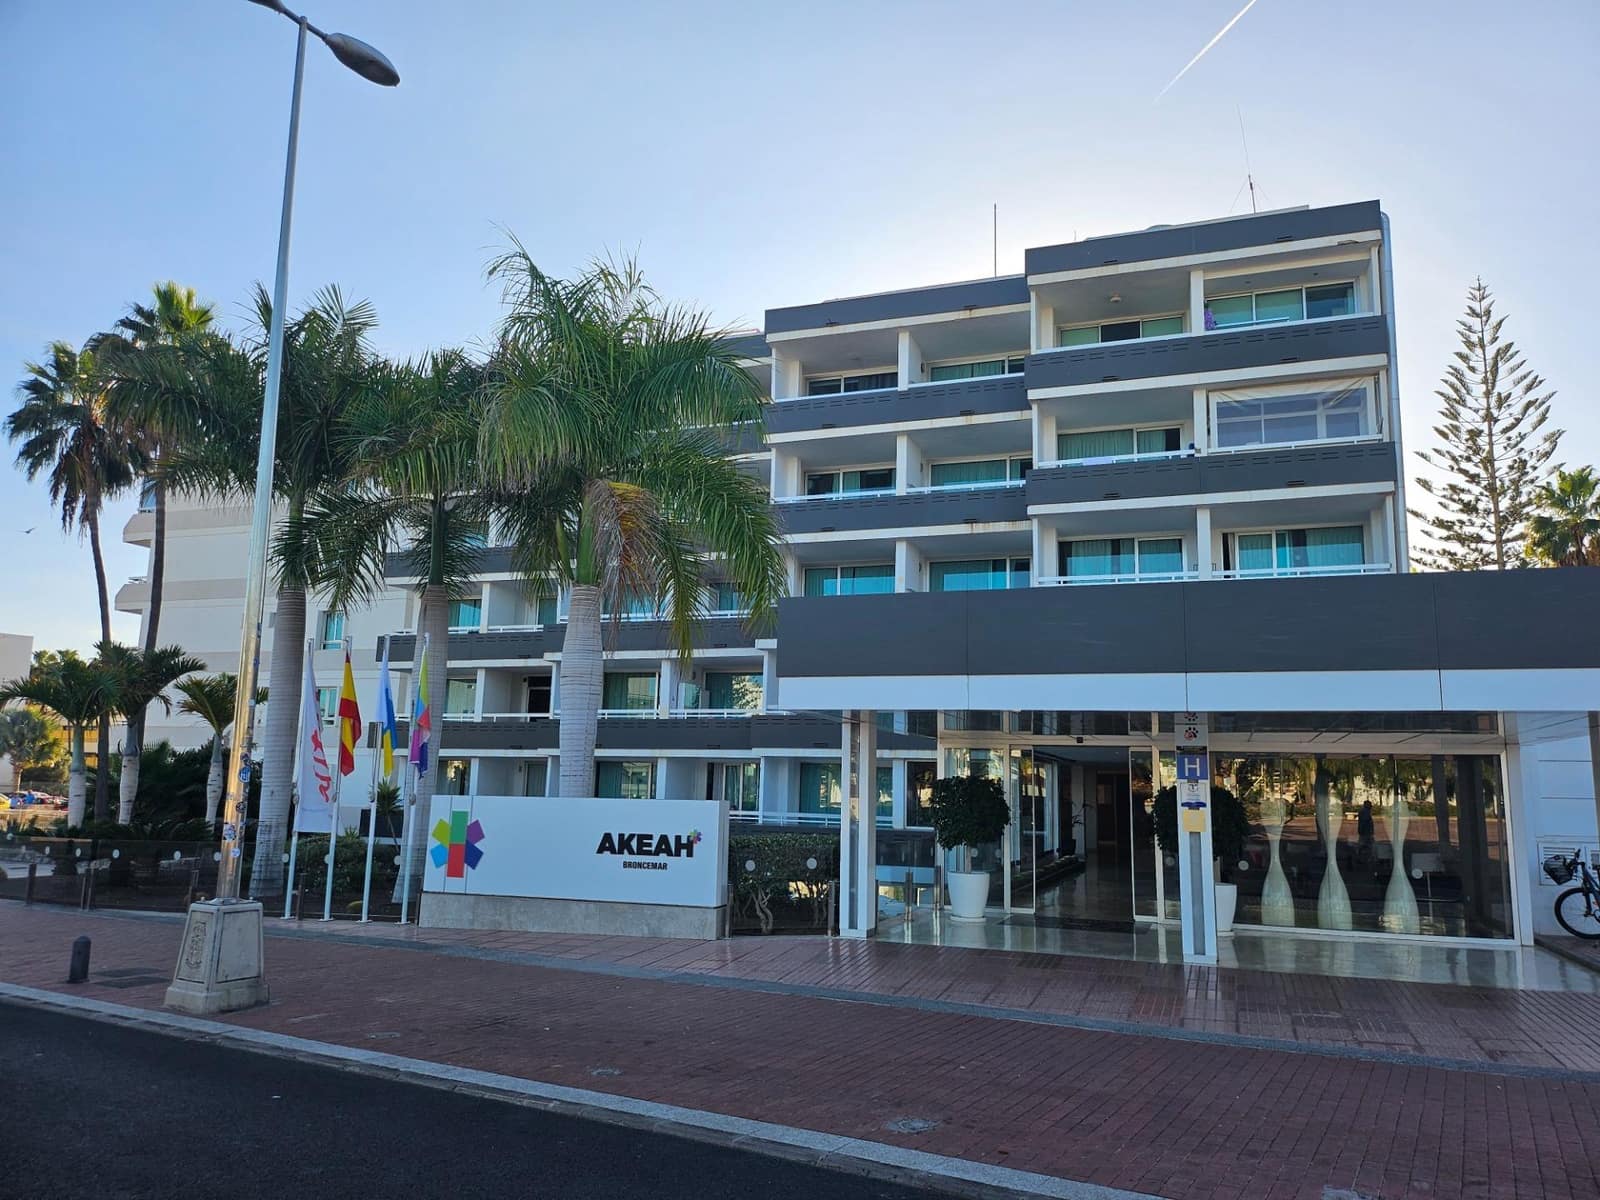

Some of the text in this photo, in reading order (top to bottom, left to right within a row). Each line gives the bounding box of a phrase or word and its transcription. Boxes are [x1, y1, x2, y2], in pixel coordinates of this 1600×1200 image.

[1184, 757, 1200, 777] H
[596, 832, 694, 858] AKEAH
[622, 861, 668, 871] BRONCEMAR
